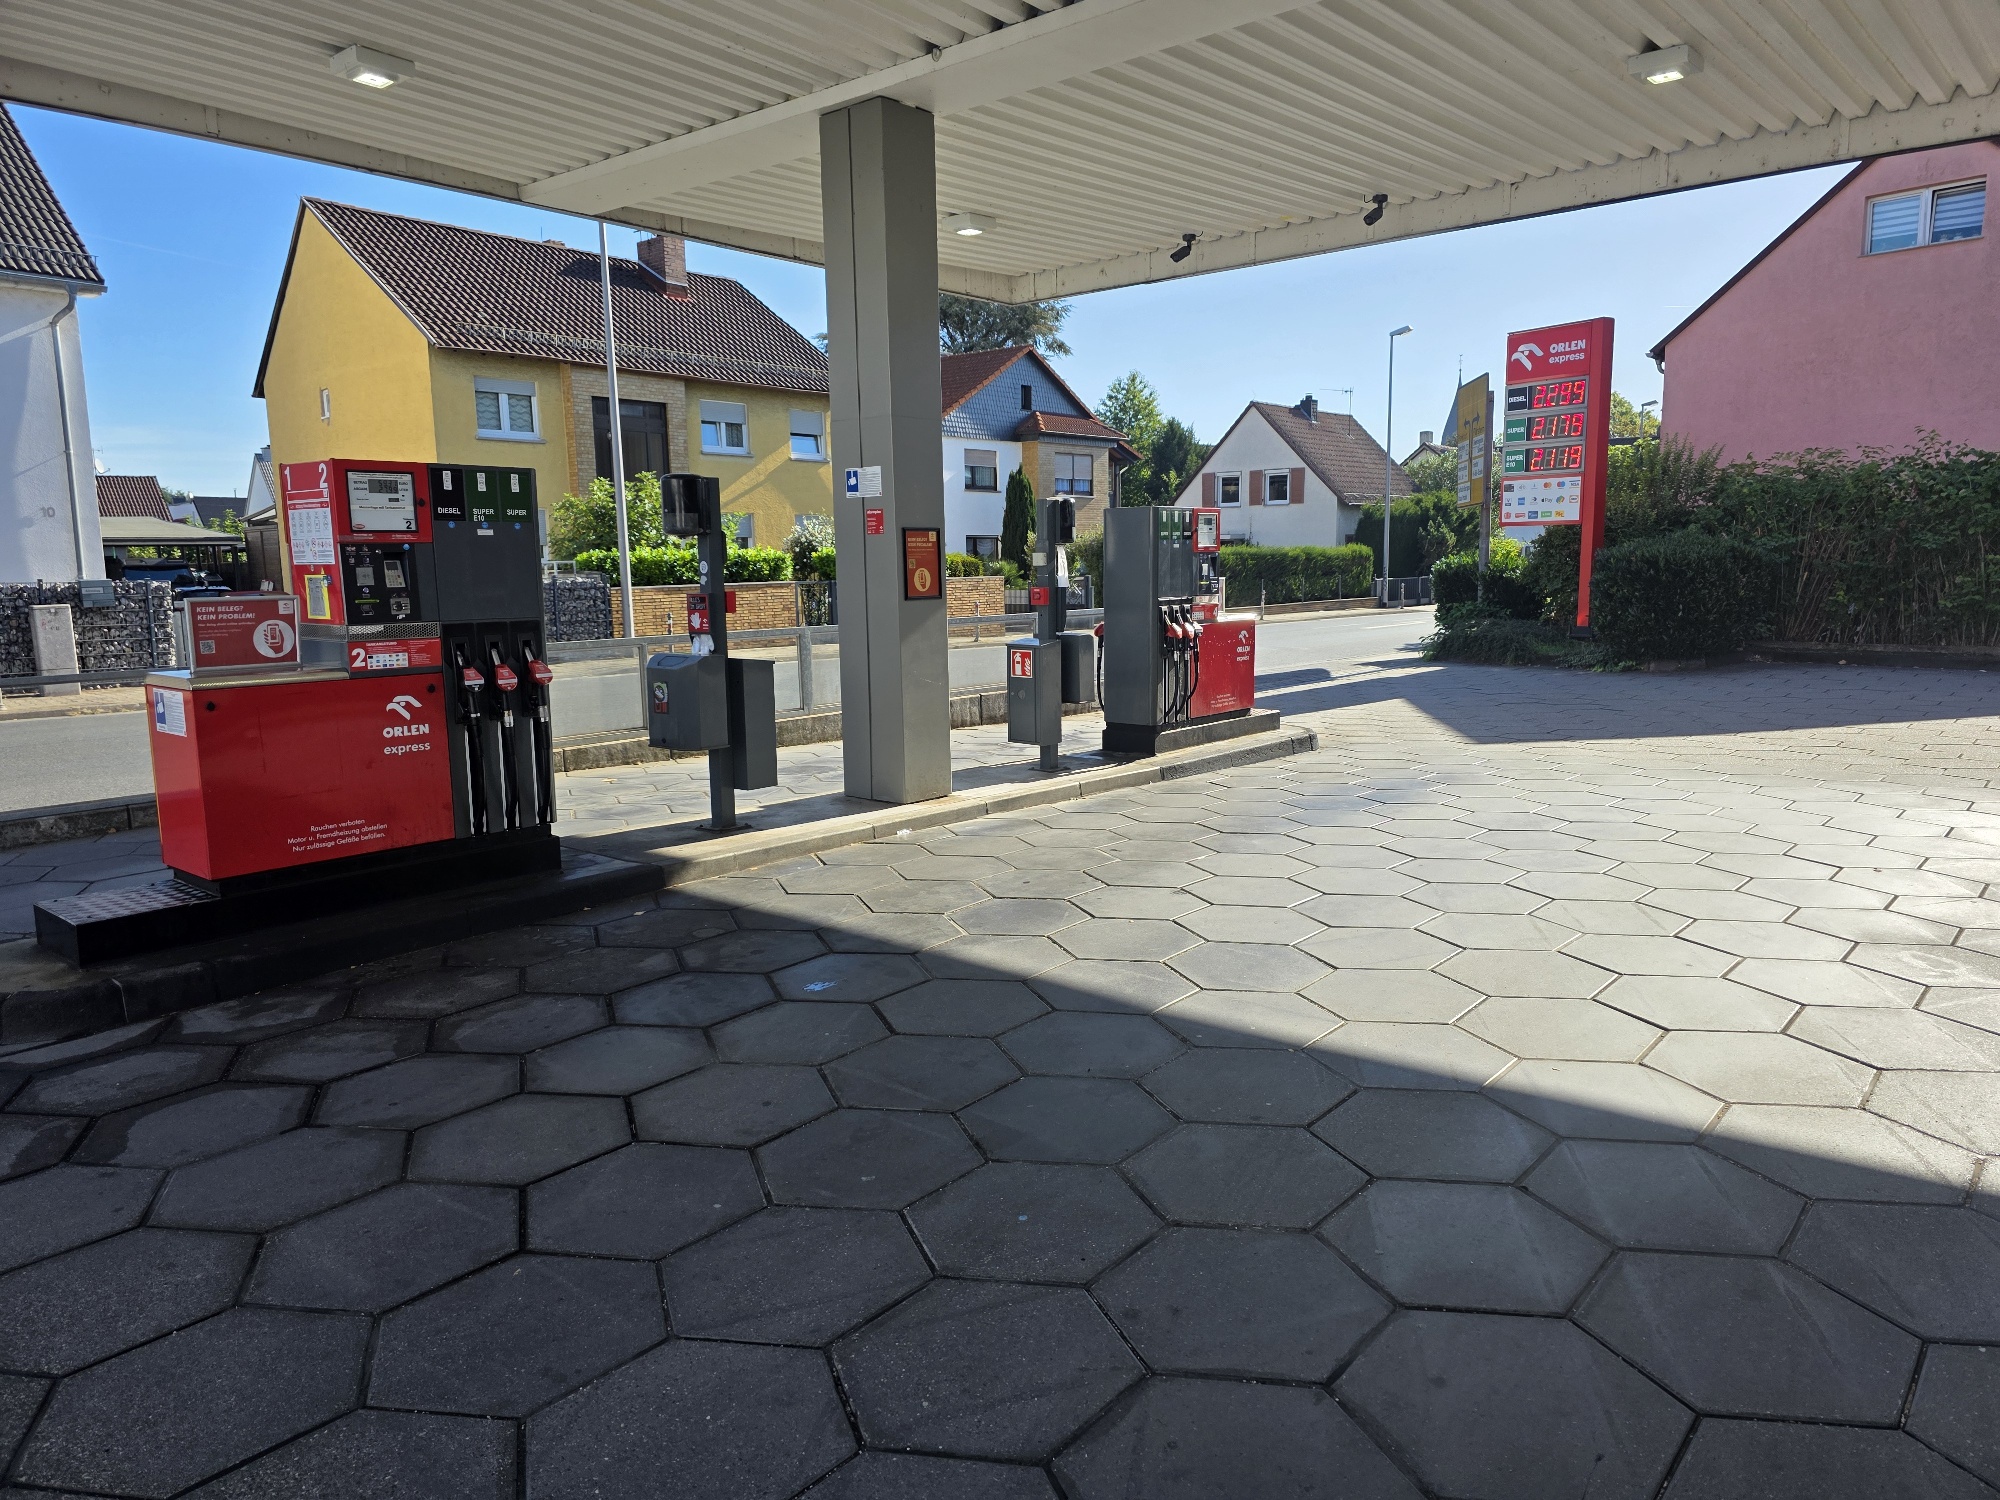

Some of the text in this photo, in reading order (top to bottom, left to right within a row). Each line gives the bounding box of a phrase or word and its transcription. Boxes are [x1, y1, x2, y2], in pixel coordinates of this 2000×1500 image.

[1549, 339, 1586, 353] ORLEN
[1549, 352, 1585, 364] express
[1508, 395, 1526, 403] DIESEL
[1533, 381, 1586, 408] 2.299
[1531, 413, 1584, 439] 2.179
[1530, 446, 1582, 471] 2.119
[284, 463, 328, 490] 1 2
[40, 506, 55, 517] 10
[437, 506, 461, 514] DIESEL
[405, 520, 412, 529] 2
[1212, 606, 1218, 617] 4
[351, 647, 366, 667] 2
[382, 723, 430, 738] ORLEN
[383, 742, 431, 755] express
[310, 819, 365, 832] Rauchen verboten
[287, 836, 307, 844] Motor
[316, 827, 360, 839] Fremdheizung
[361, 823, 388, 832] abstellen
[306, 840, 335, 850] zulässige
[336, 835, 360, 845] Gefäße
